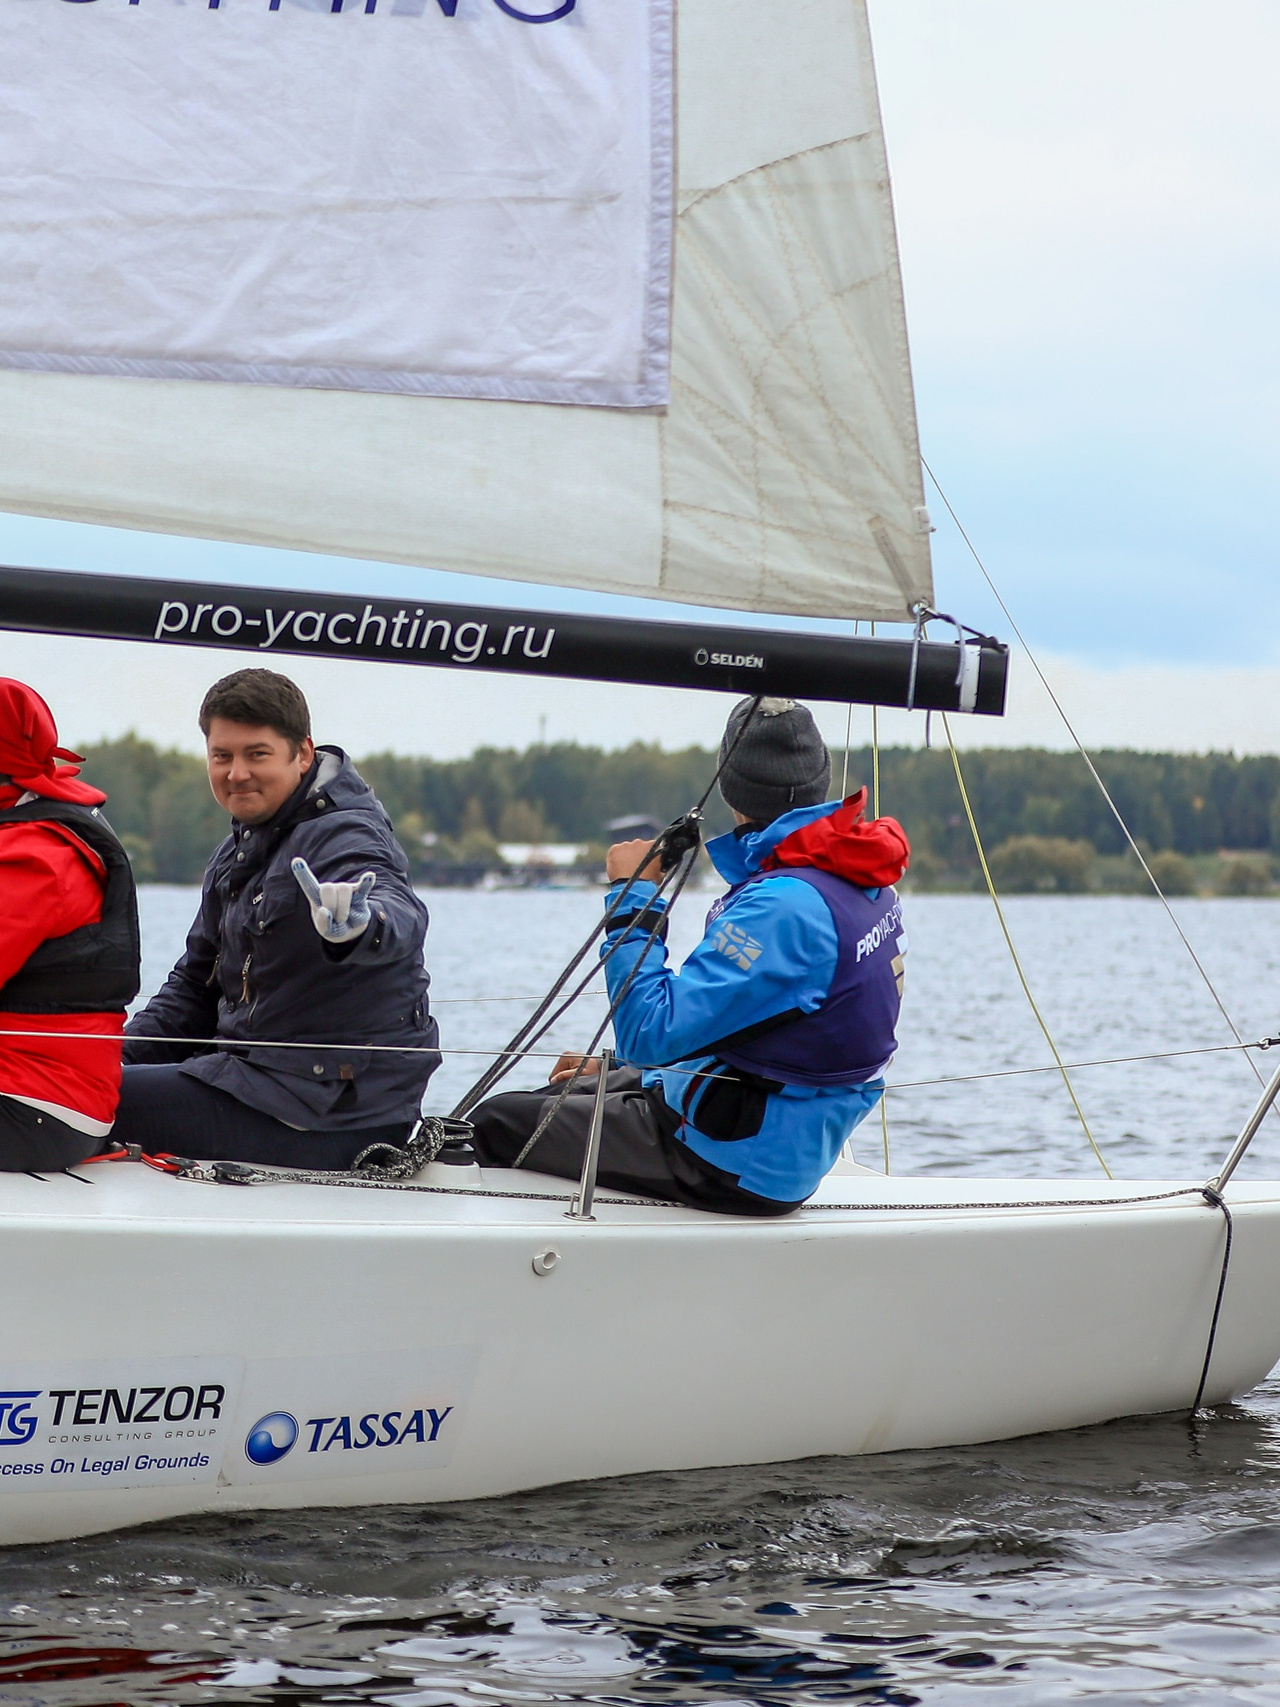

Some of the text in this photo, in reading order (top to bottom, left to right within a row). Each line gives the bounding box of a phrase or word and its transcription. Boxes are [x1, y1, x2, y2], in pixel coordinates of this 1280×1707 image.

[154, 601, 556, 663] pro-yachting.ru
[49, 1384, 225, 1426] TENZOR
[48, 1429, 217, 1444] CONSULTING GROUP
[305, 1406, 454, 1453] TASSAY
[50, 1458, 75, 1474] On
[80, 1456, 131, 1476] Legal
[134, 1452, 210, 1470] Grounds
